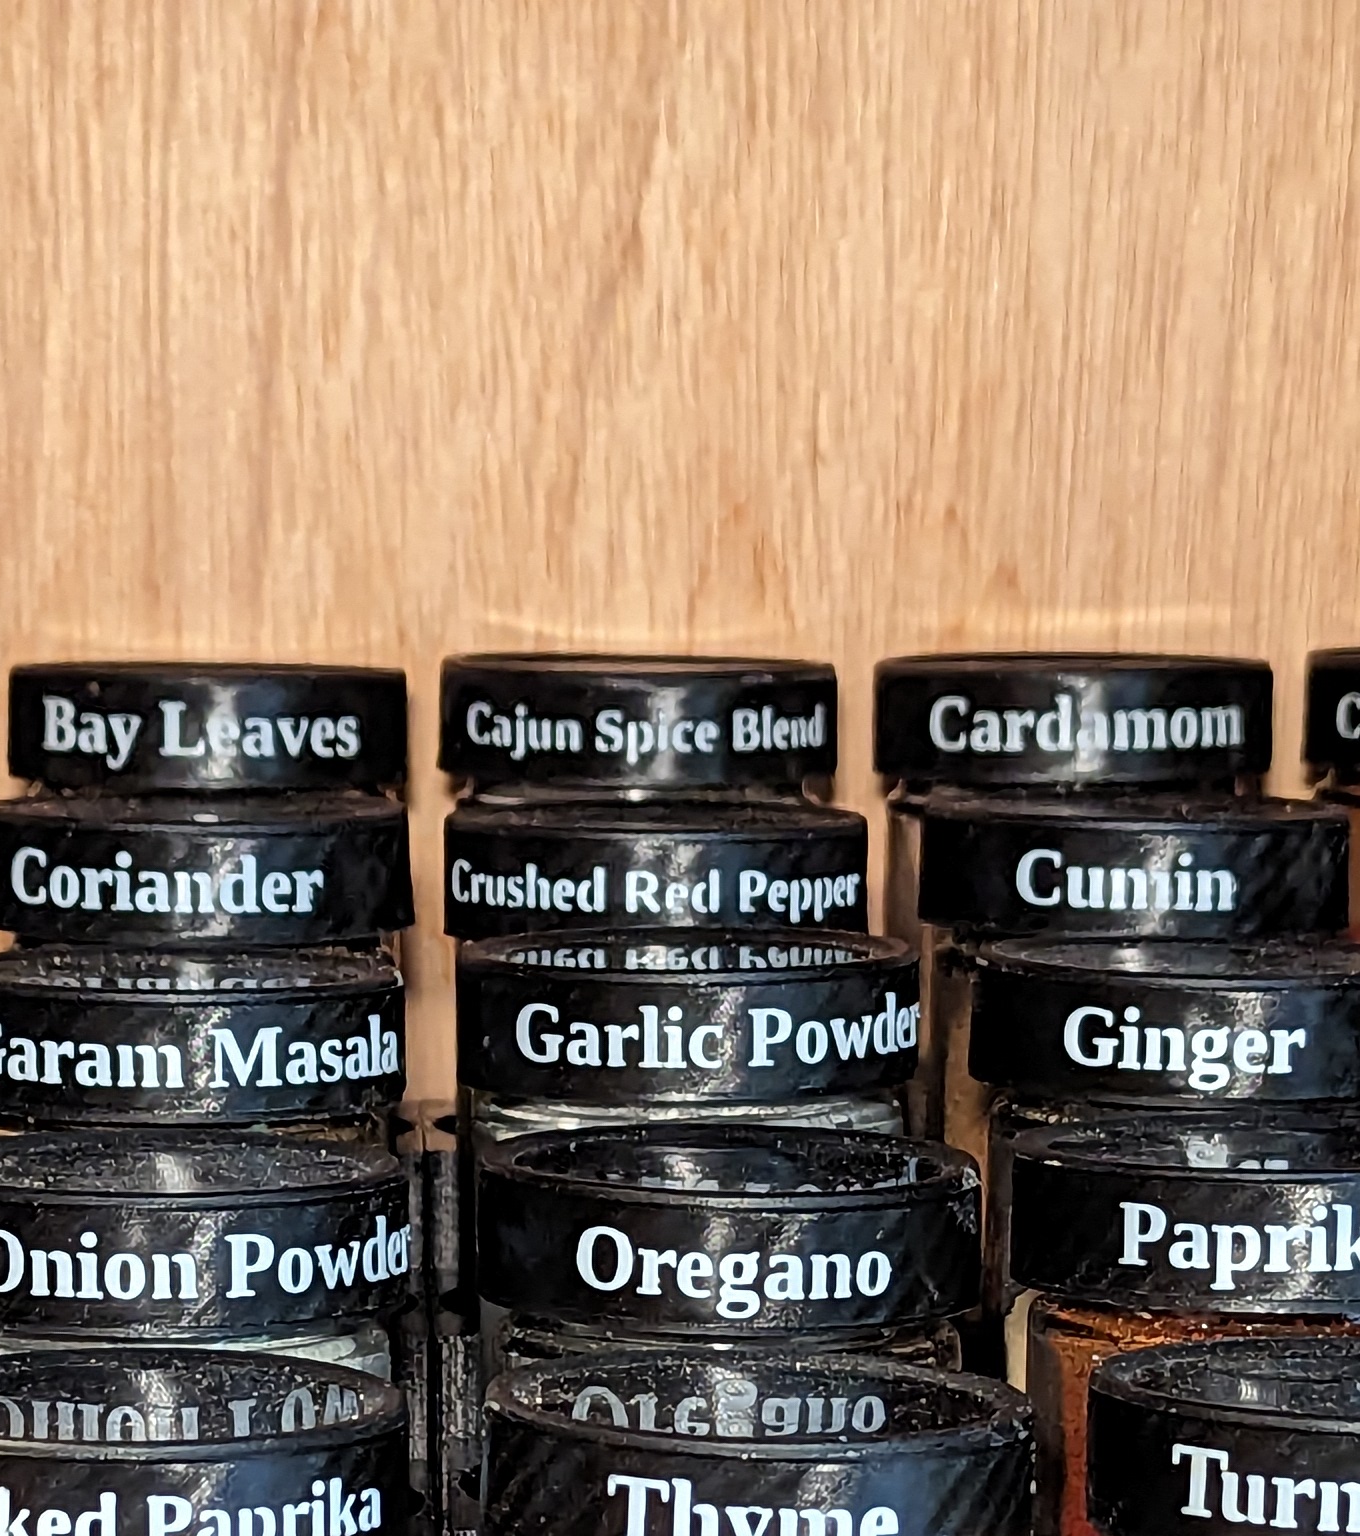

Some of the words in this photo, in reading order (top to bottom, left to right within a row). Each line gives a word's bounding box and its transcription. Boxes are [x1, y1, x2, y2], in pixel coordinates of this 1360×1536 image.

[43, 696, 141, 768] Bay
[159, 700, 361, 760] Leaves
[466, 703, 583, 760] Cajun
[595, 710, 719, 764] Spice
[733, 703, 825, 751] Blend
[929, 696, 1243, 754] Cardamom
[11, 846, 325, 914] Coriander
[451, 858, 604, 913] Crushed
[625, 868, 720, 915] Red
[739, 867, 861, 922] Pepper
[1016, 848, 1237, 912] Cumin
[213, 1014, 398, 1088] Masala
[515, 1003, 723, 1069] Garlic
[747, 992, 921, 1067] Powder
[1063, 1006, 1306, 1092] Ginger
[224, 1215, 411, 1299] Powder
[575, 1227, 893, 1318] Oregano
